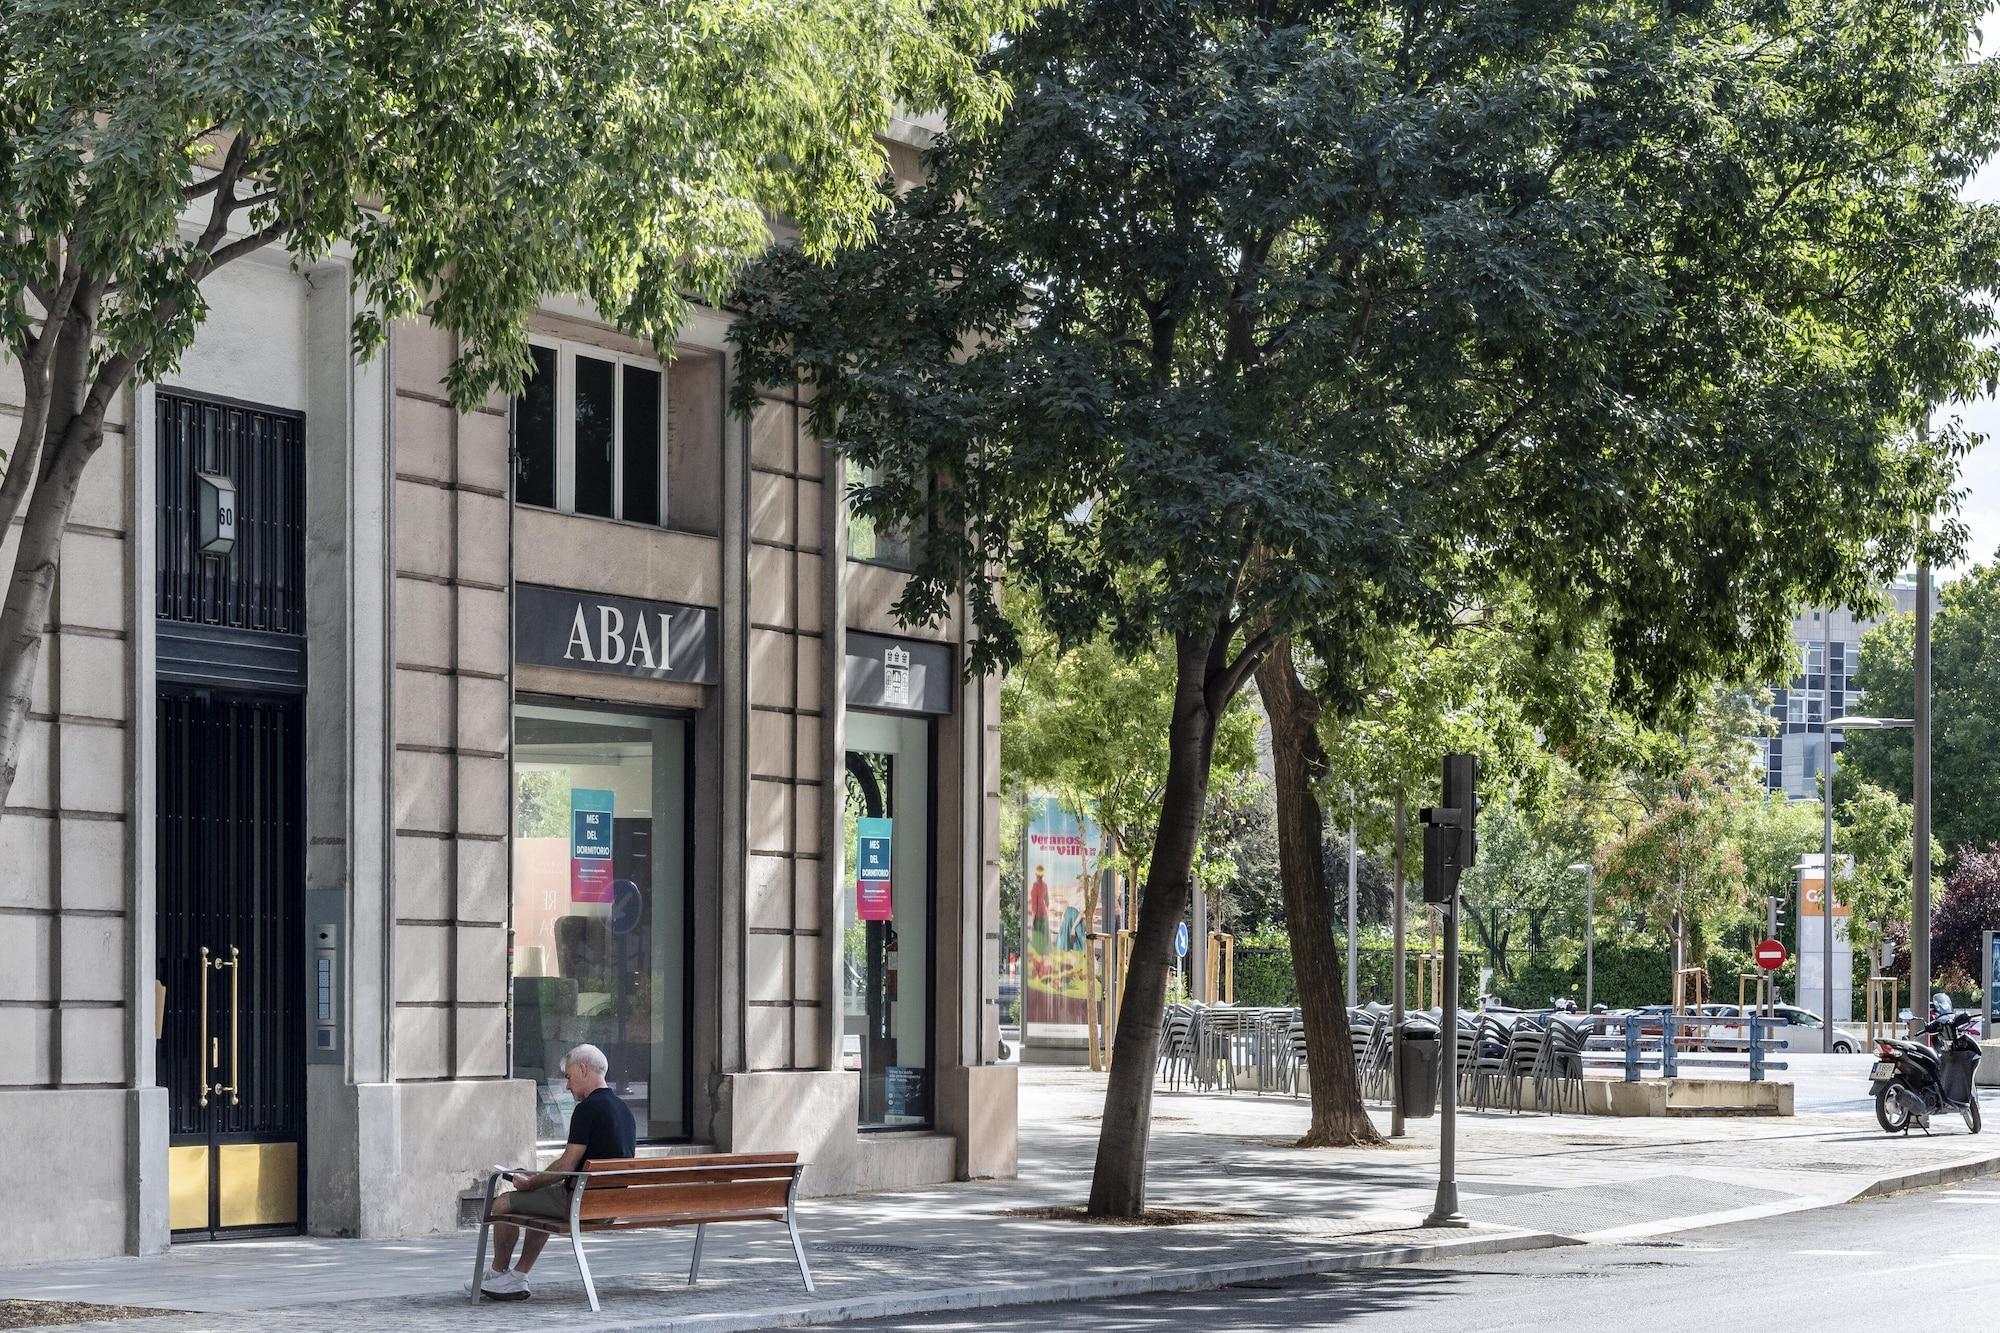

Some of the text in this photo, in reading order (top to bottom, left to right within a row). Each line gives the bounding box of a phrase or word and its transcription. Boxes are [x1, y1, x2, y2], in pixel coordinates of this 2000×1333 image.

[219, 507, 232, 526] 60
[563, 601, 673, 671] ABAI
[586, 814, 599, 824] MES
[587, 830, 597, 840] DEL
[1031, 835, 1080, 844] Veranos
[869, 840, 880, 849] MES
[577, 845, 609, 855] DORMITORIO
[870, 855, 879, 864] DEL
[862, 869, 889, 877] DORMITORIO
